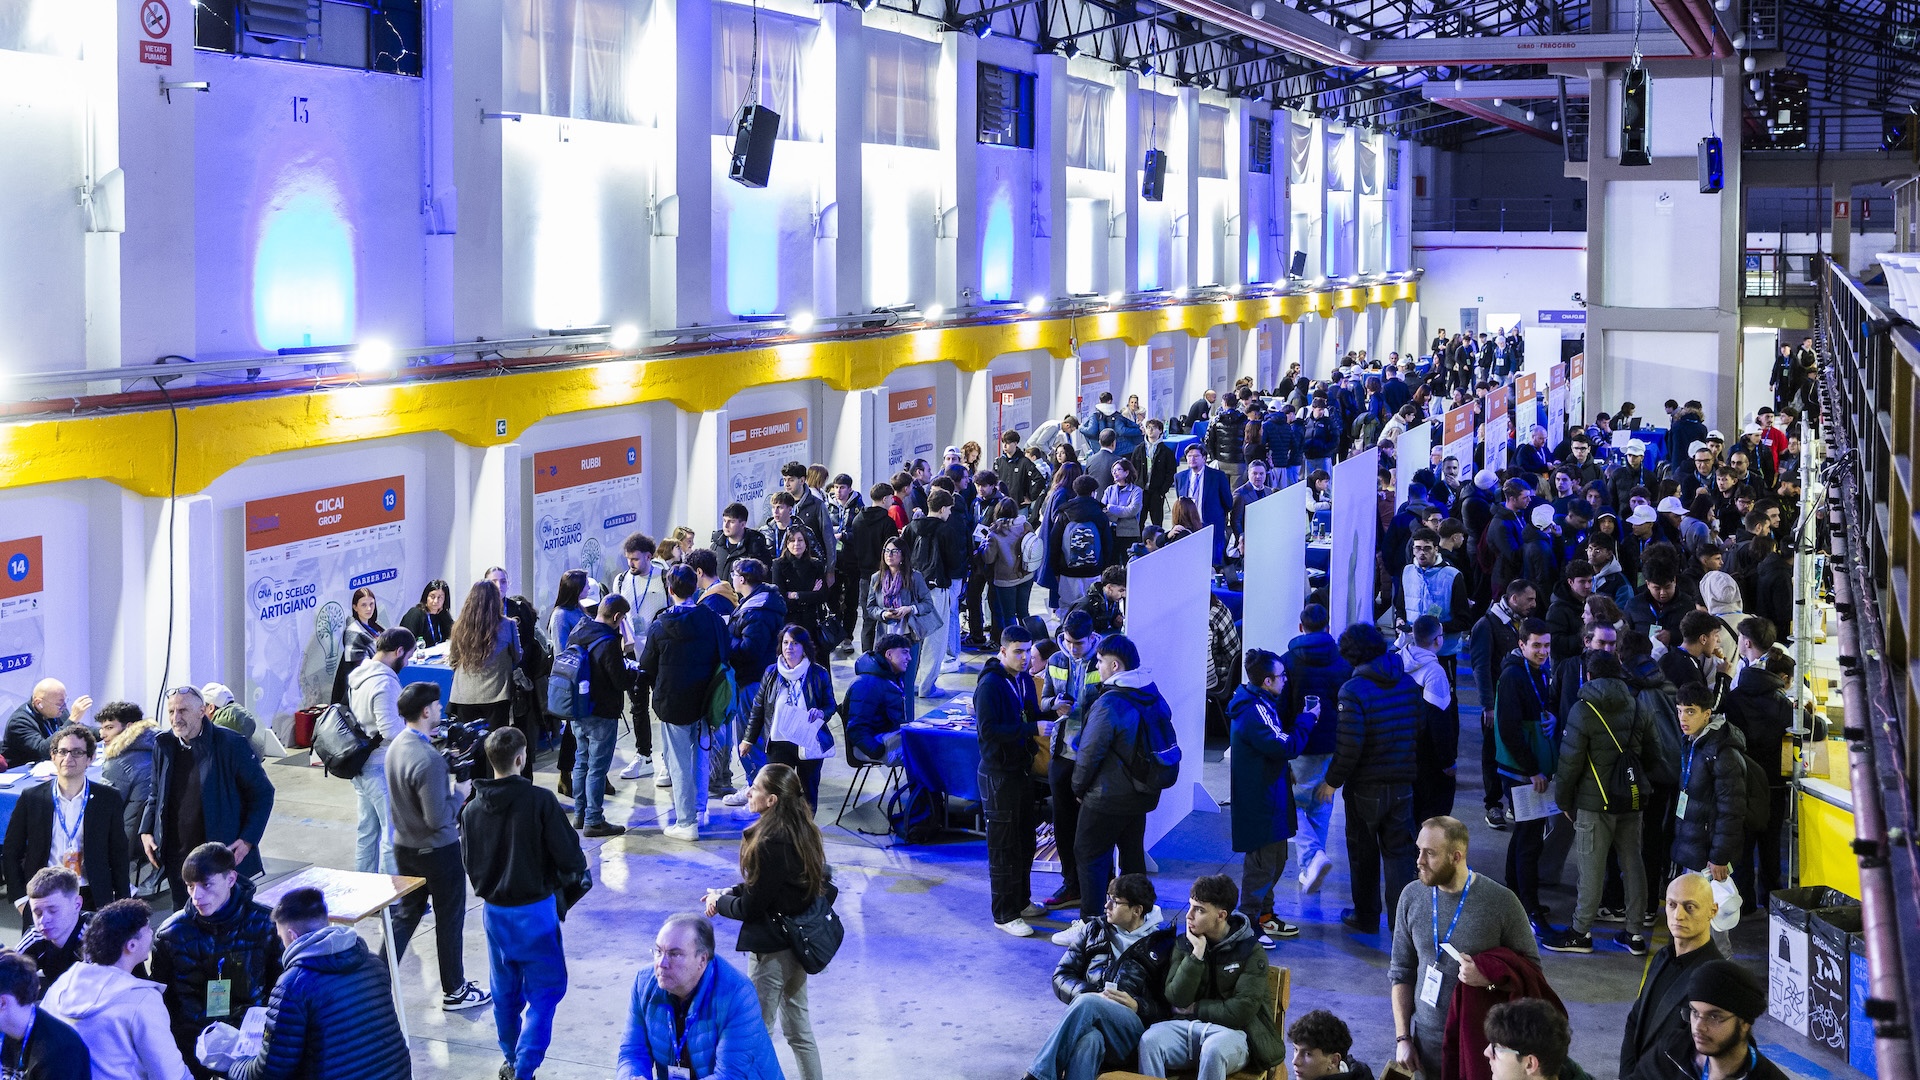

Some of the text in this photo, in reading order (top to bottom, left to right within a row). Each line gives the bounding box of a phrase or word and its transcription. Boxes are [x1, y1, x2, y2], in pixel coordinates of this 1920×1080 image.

[144, 45, 167, 54] VIETATO
[144, 53, 168, 62] FUMARE
[769, 422, 790, 435] IMPIANTI
[581, 456, 601, 471] RUBBI
[627, 451, 635, 462] 12
[315, 496, 345, 514] CIICAI
[385, 494, 395, 506] 13
[318, 513, 343, 527] GROUP
[552, 522, 582, 537] IO SCELGO
[543, 532, 582, 551] ARTIGIANO
[11, 559, 26, 575] 14
[352, 569, 396, 588] CAREER DAY
[257, 587, 272, 599] CNA
[273, 583, 316, 602] IO SCELGO
[260, 595, 317, 621] ARTIGIANO
[7, 655, 29, 669] DAY
